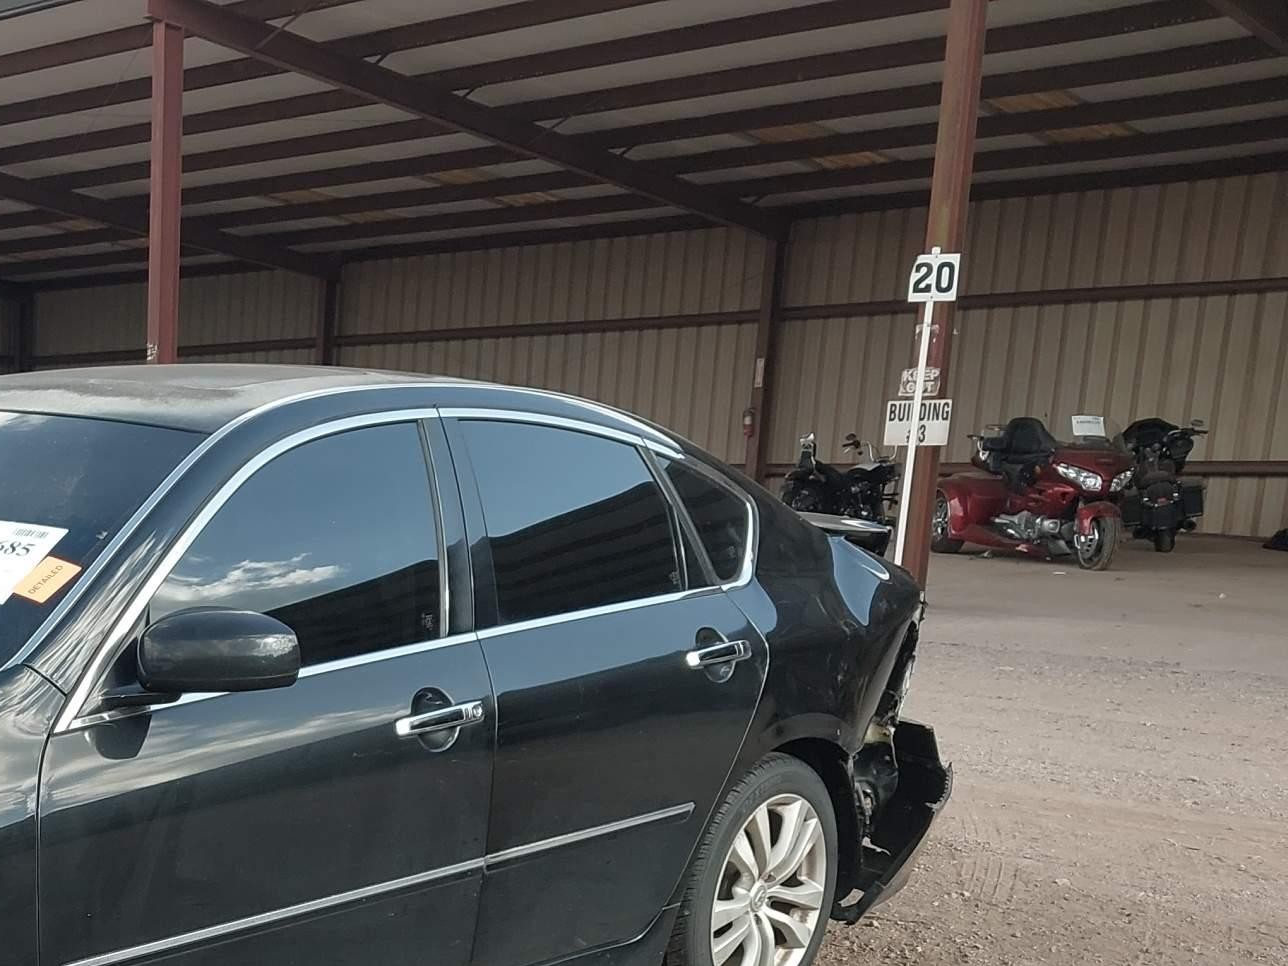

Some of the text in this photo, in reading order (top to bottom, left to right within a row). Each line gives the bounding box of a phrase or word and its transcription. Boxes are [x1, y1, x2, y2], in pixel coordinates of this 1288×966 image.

[912, 261, 955, 294] 20
[906, 382, 935, 393] OT
[888, 402, 950, 422] BUIDING
[27, 565, 64, 595] DETAILED
